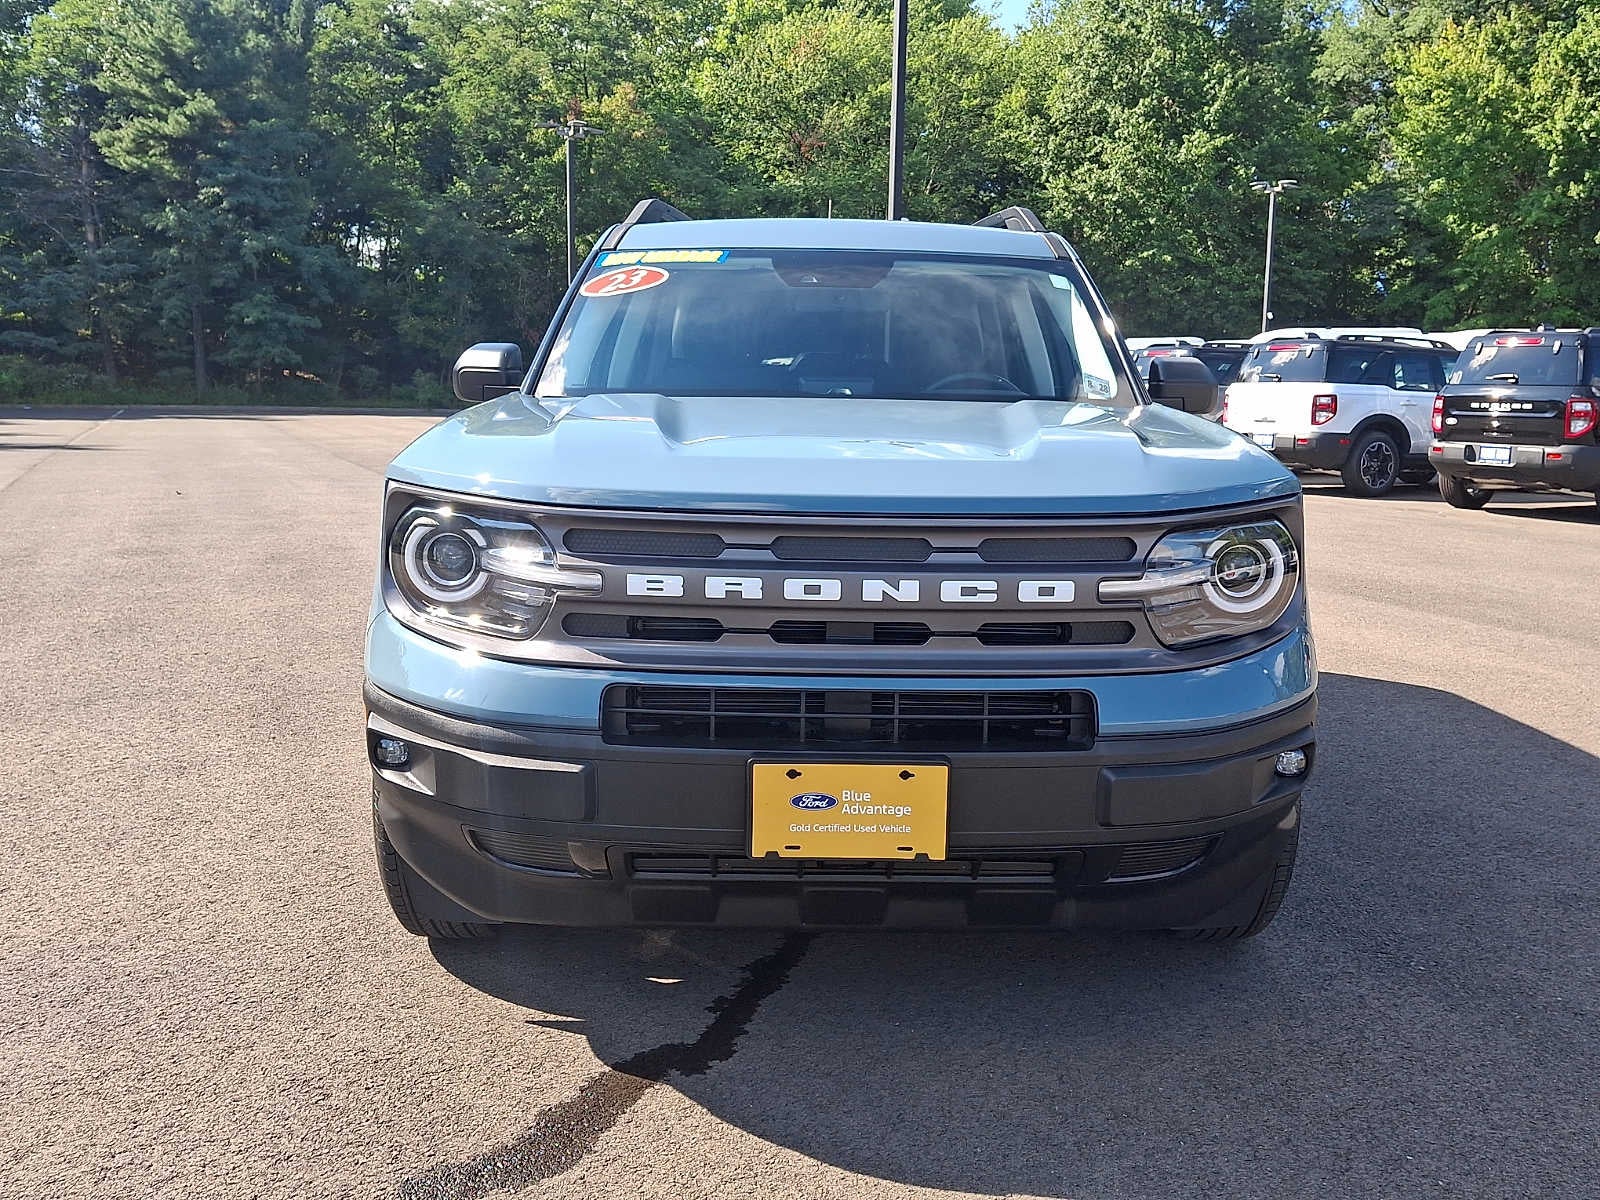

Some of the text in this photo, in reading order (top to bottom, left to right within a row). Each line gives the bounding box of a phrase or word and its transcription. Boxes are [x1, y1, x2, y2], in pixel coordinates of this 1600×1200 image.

[600, 269, 647, 293] 23
[626, 573, 1076, 603] BRONCO
[798, 795, 829, 808] Ford
[842, 790, 871, 802] Blue
[841, 804, 912, 817] Advantage
[789, 823, 912, 833] Gold Certified Used Vehicle
